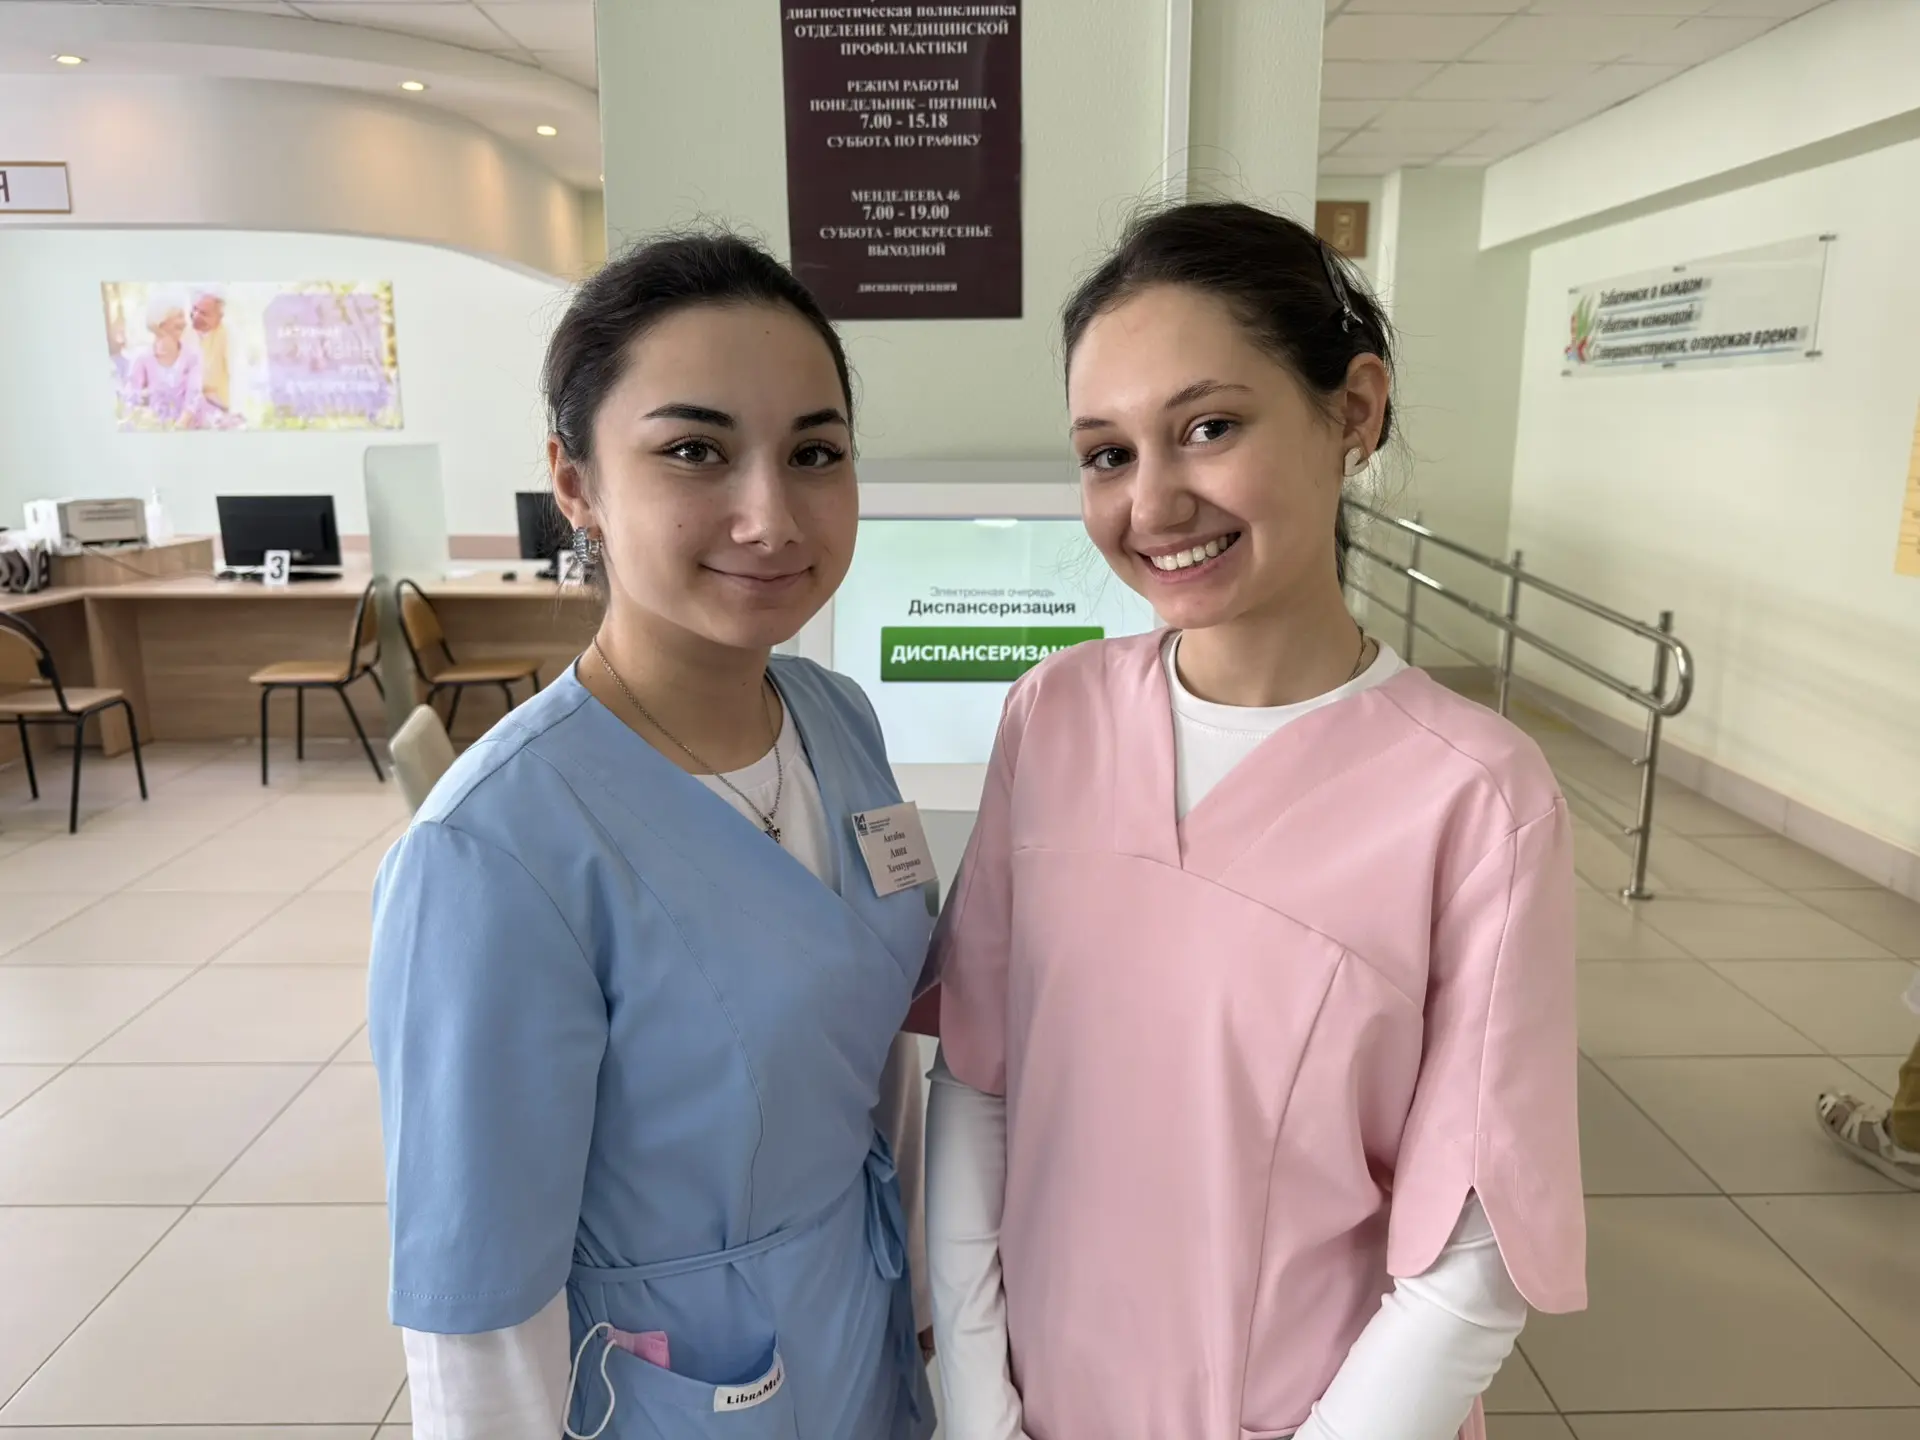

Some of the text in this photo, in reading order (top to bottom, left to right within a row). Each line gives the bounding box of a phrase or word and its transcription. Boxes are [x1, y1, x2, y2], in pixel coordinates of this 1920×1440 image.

[786, 4, 1017, 20] диагностическая поликлиника
[794, 19, 1009, 39] ОТДЕЛЕНИЕ МЕДИЦИНСКОЙ
[840, 41, 968, 56] ПРОФИЛАКТИКИ
[847, 79, 959, 93] РЕЖИМ РАБОТЫ
[809, 99, 916, 112] ПОНЕДЕЛЬНИК
[928, 97, 997, 111] ПЯТНИЦА
[860, 114, 893, 129] 7.00
[908, 113, 949, 129] 15.18
[826, 133, 982, 148] СУББОТА ПО ГРАФИКУ
[851, 190, 961, 203] МЕНДЕЛЕЕВА 46
[862, 205, 895, 221] 7.00
[910, 204, 950, 220] 19.00
[819, 227, 884, 239] СУББОТА
[893, 225, 993, 239] ВОСКРЕСЕНЬЕ
[867, 243, 946, 258] ВЫХОДНОЙ
[1752, 327, 1798, 349] время
[270, 555, 283, 579] 3
[907, 600, 1076, 618] Диспансеризация
[890, 645, 1072, 664] ДИСПАНСЕРИЗА
